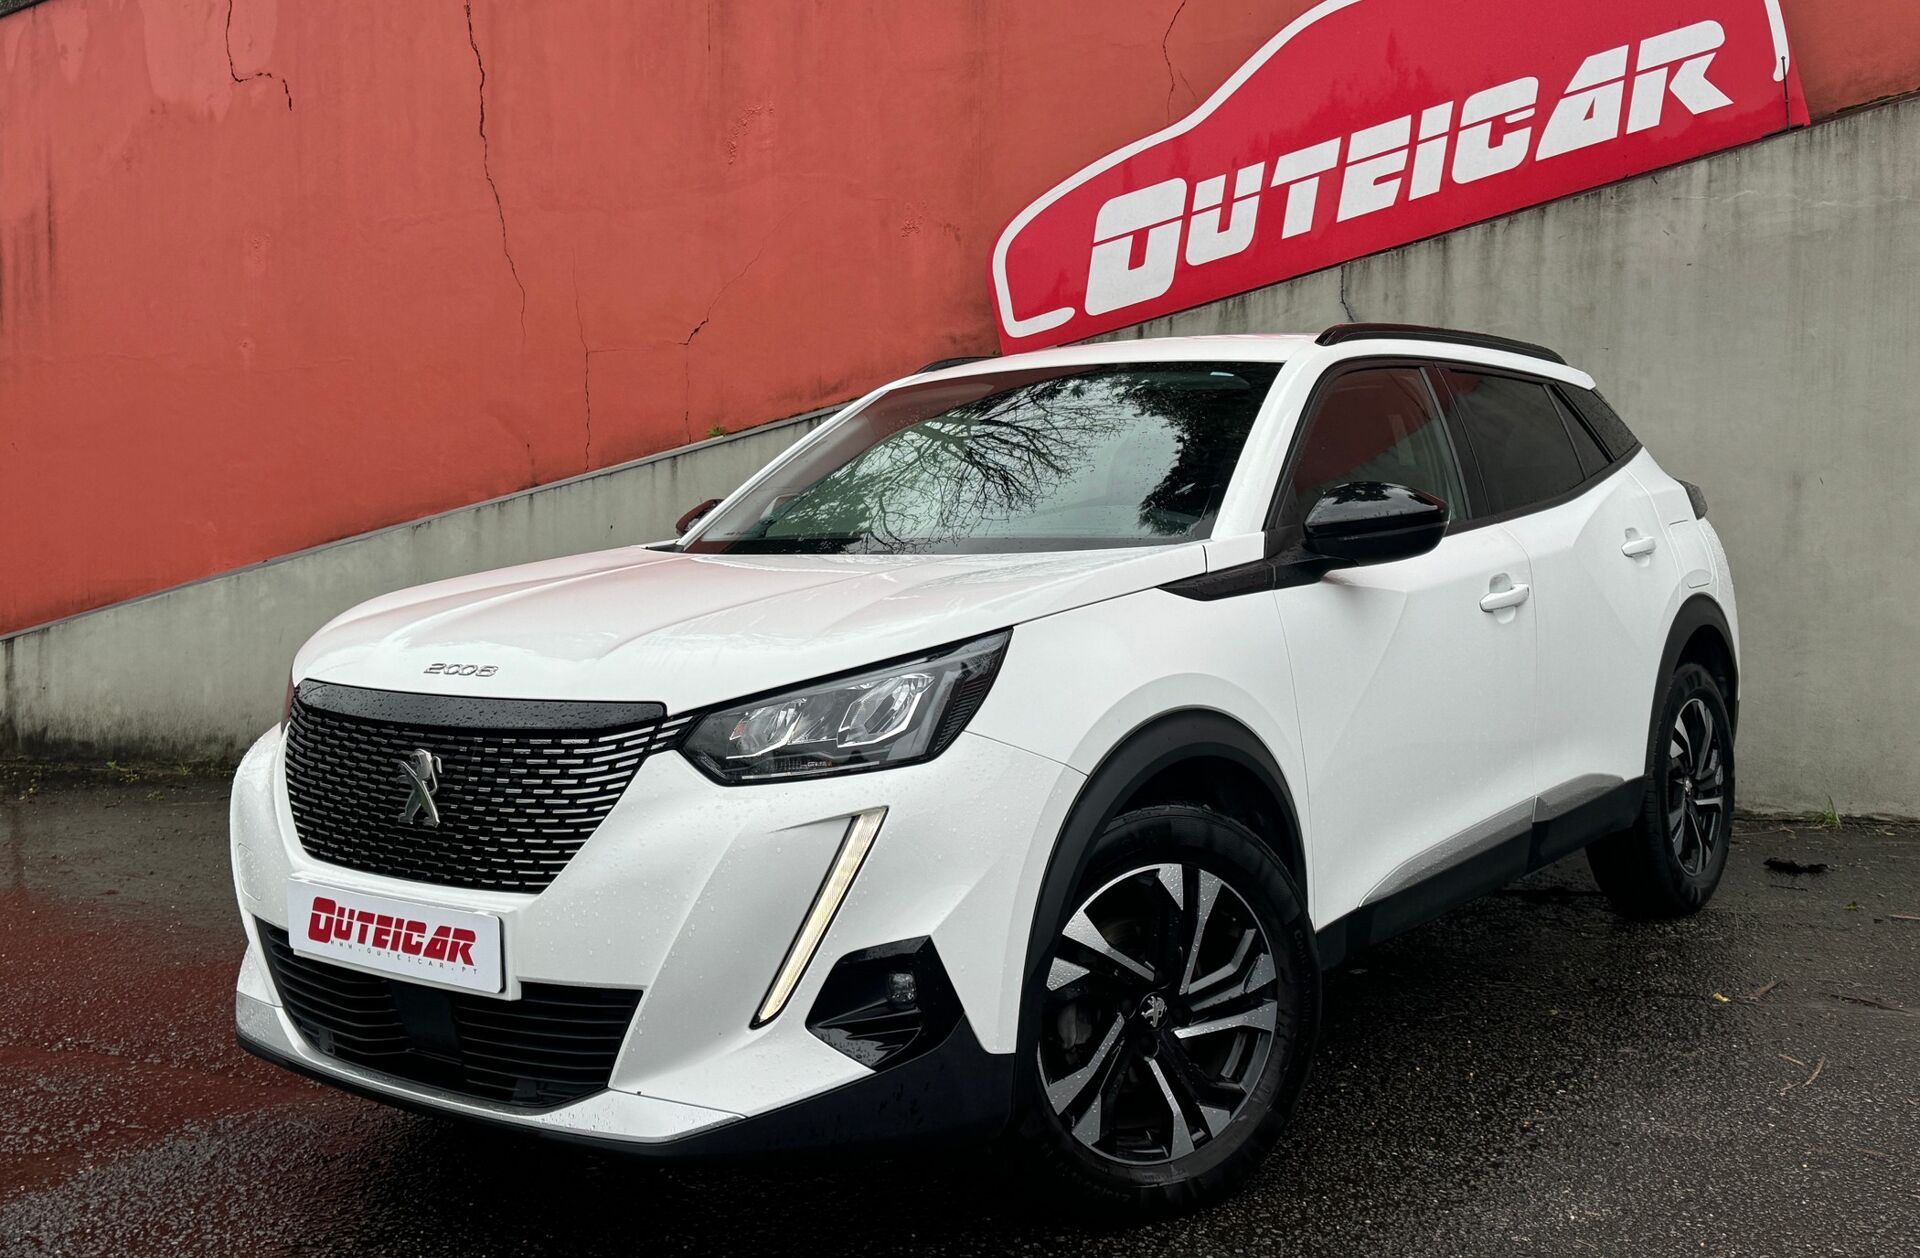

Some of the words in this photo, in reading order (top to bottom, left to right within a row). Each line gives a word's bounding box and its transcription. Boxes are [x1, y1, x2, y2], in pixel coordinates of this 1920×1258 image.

[1085, 19, 1734, 316] OUTEICAR
[423, 663, 499, 678] 2008
[307, 896, 477, 967] OUTEICAR
[330, 939, 478, 975] WWW.OUTEICAR.PT
